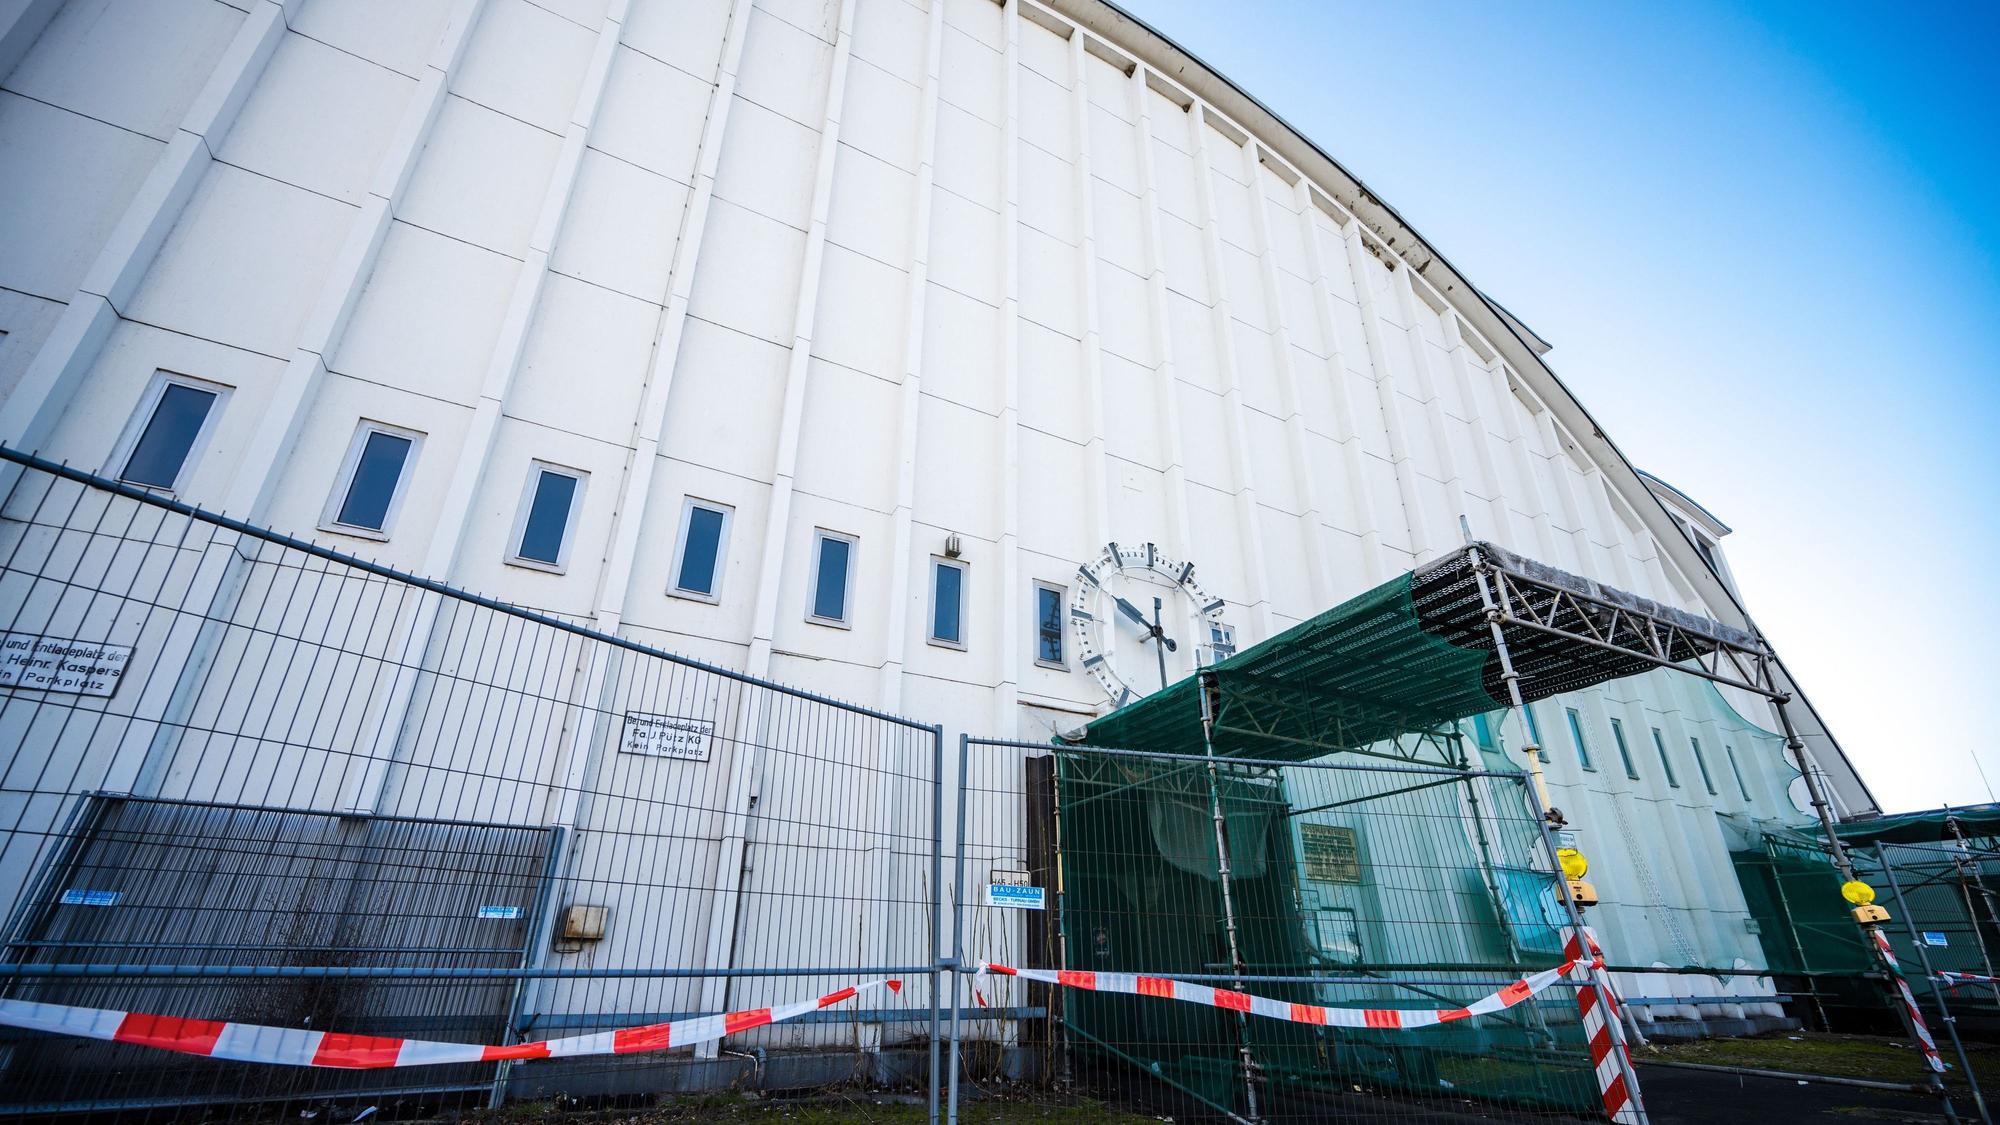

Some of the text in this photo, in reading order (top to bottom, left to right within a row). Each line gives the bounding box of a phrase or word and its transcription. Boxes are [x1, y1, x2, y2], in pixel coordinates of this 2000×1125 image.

[6, 639, 31, 650] und
[31, 641, 105, 660] Entladeplatz
[6, 653, 121, 677] Heinr. Kaspers
[0, 669, 104, 690] in Parkplatz
[639, 718, 654, 727] und
[627, 741, 703, 757] Kein Parkplatz
[688, 735, 701, 745] KG
